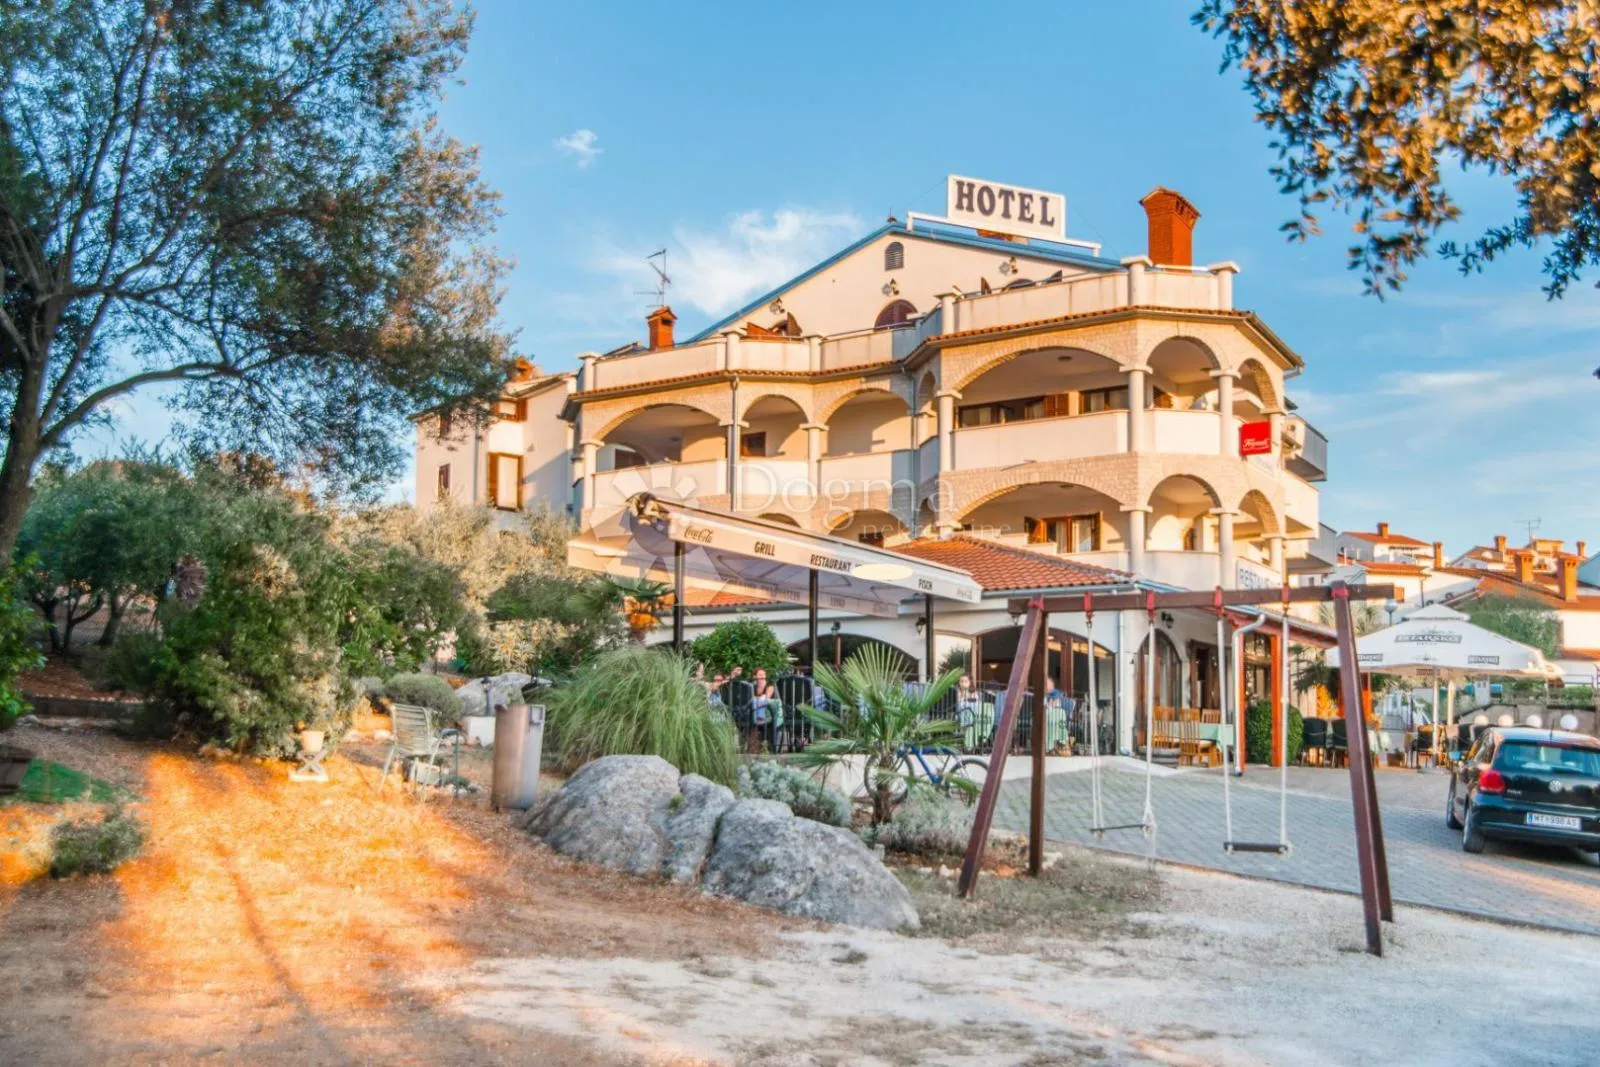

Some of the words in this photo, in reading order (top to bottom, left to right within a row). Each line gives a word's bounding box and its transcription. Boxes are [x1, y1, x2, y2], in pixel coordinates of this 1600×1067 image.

[955, 180, 1055, 226] HOTEL
[754, 541, 776, 557] GRILL
[810, 554, 852, 573] RESTAURANT
